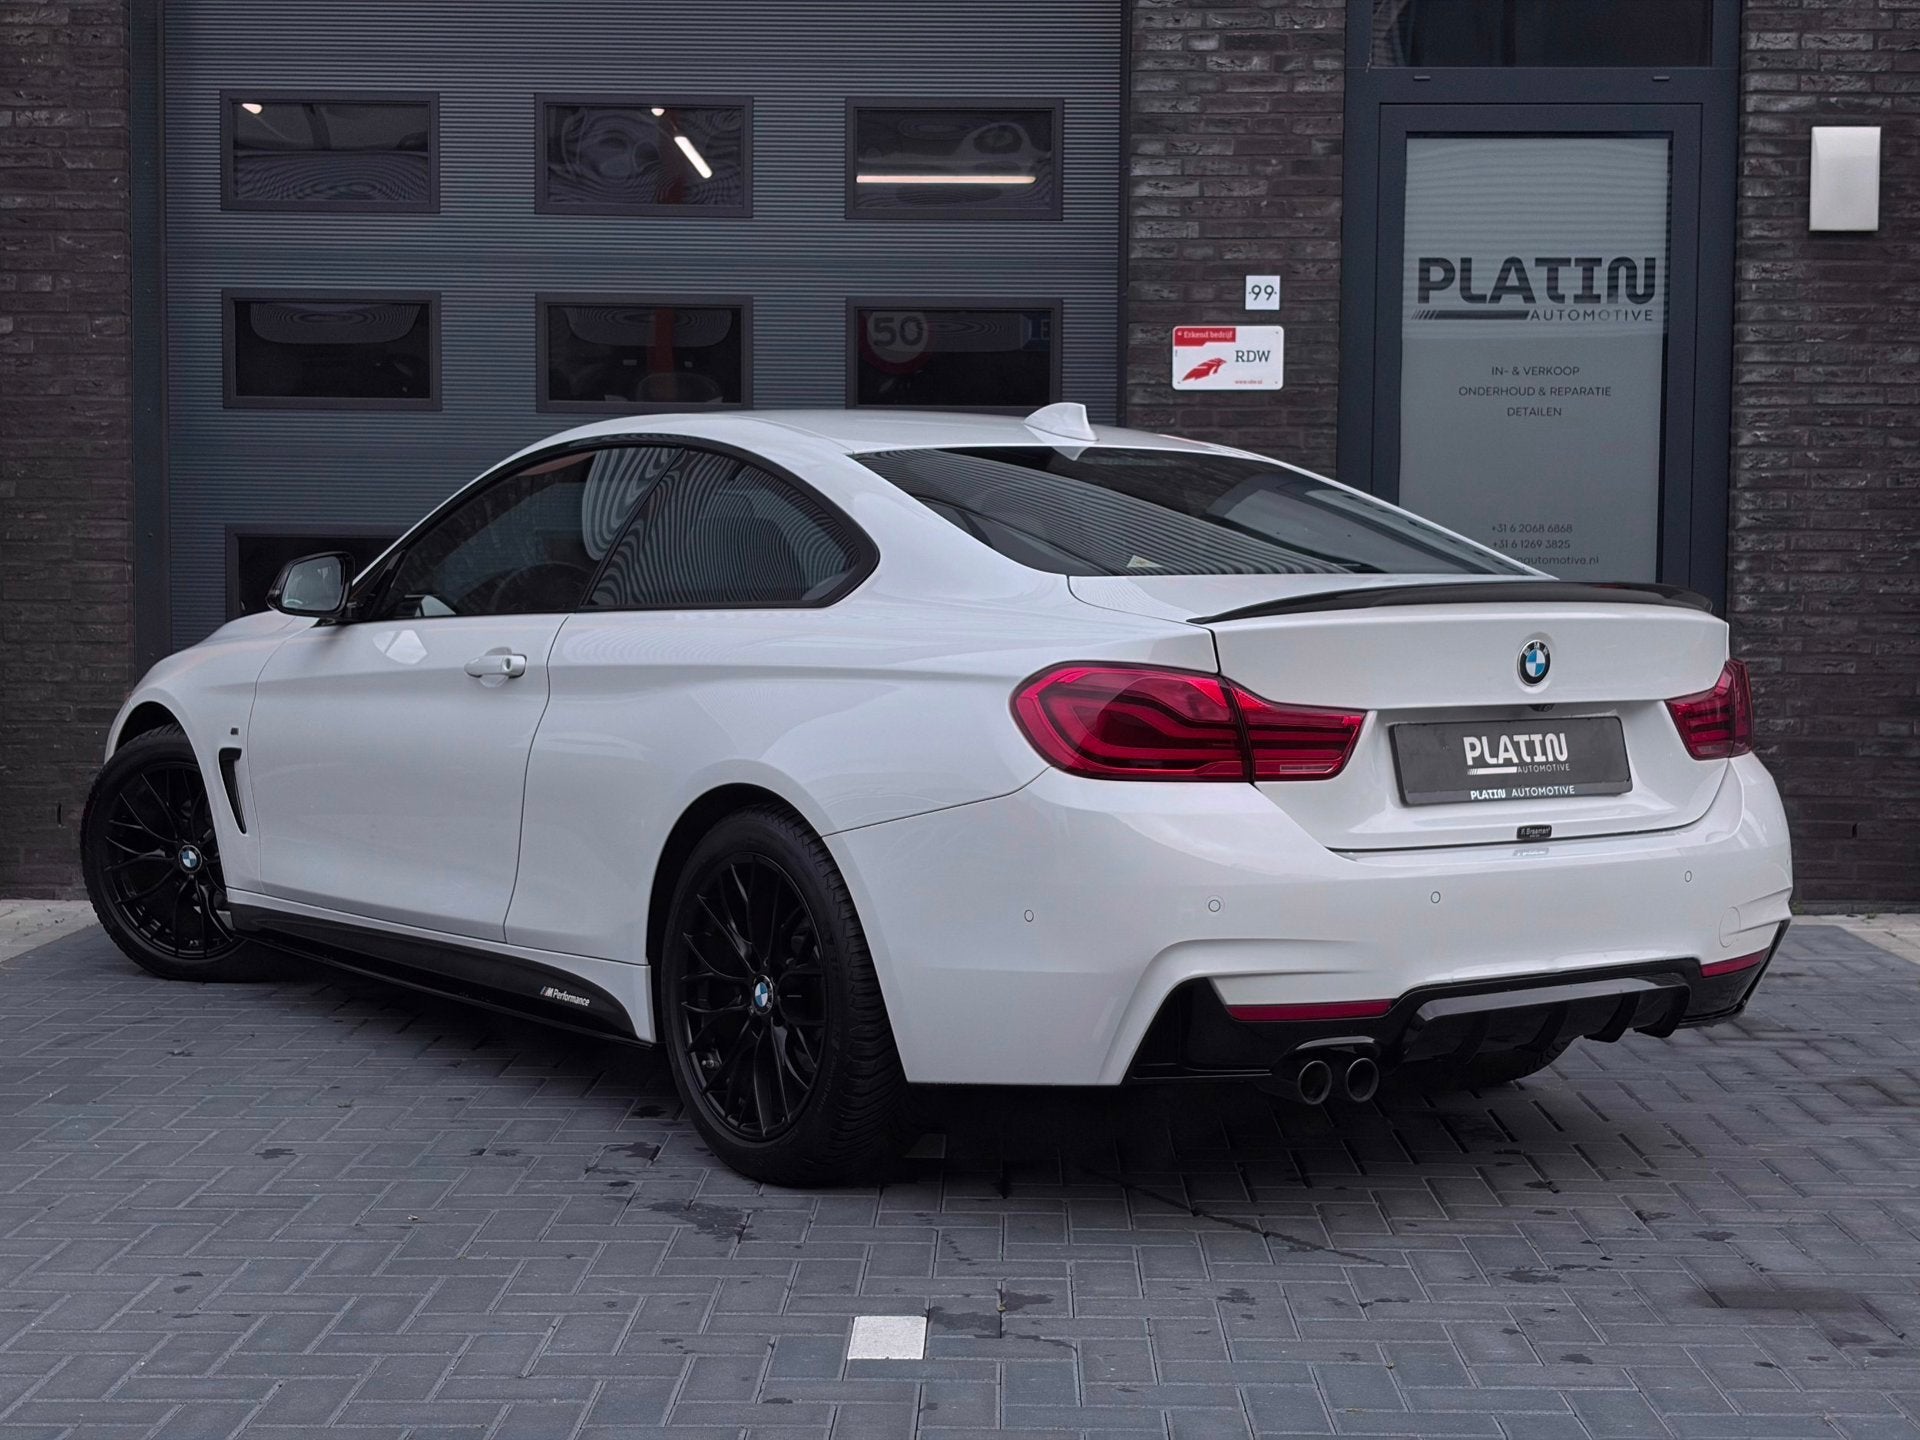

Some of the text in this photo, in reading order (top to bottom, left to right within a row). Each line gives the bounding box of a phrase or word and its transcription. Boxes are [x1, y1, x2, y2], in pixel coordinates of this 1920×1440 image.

[1417, 256, 1656, 305] PLATIN
[1251, 284, 1275, 301] 99
[1530, 310, 1653, 322] AUTOMOTIVE
[873, 316, 923, 346] 50
[1235, 350, 1271, 362] RDW
[1491, 366, 1580, 376] IN- & VERKOOP
[1458, 386, 1612, 397] ONDERHOUD & REPARATIE
[1506, 406, 1562, 417] DETAILEN
[1492, 523, 1573, 533] +31 6 2068 6868
[1493, 539, 1571, 549] +31 6 1269 3825
[1463, 733, 1568, 765] PLATIN
[1517, 763, 1571, 774] AUTOMOTIVE
[1470, 785, 1576, 800] PLATIN AUTOMOTIVE
[553, 988, 590, 1006] Performance
